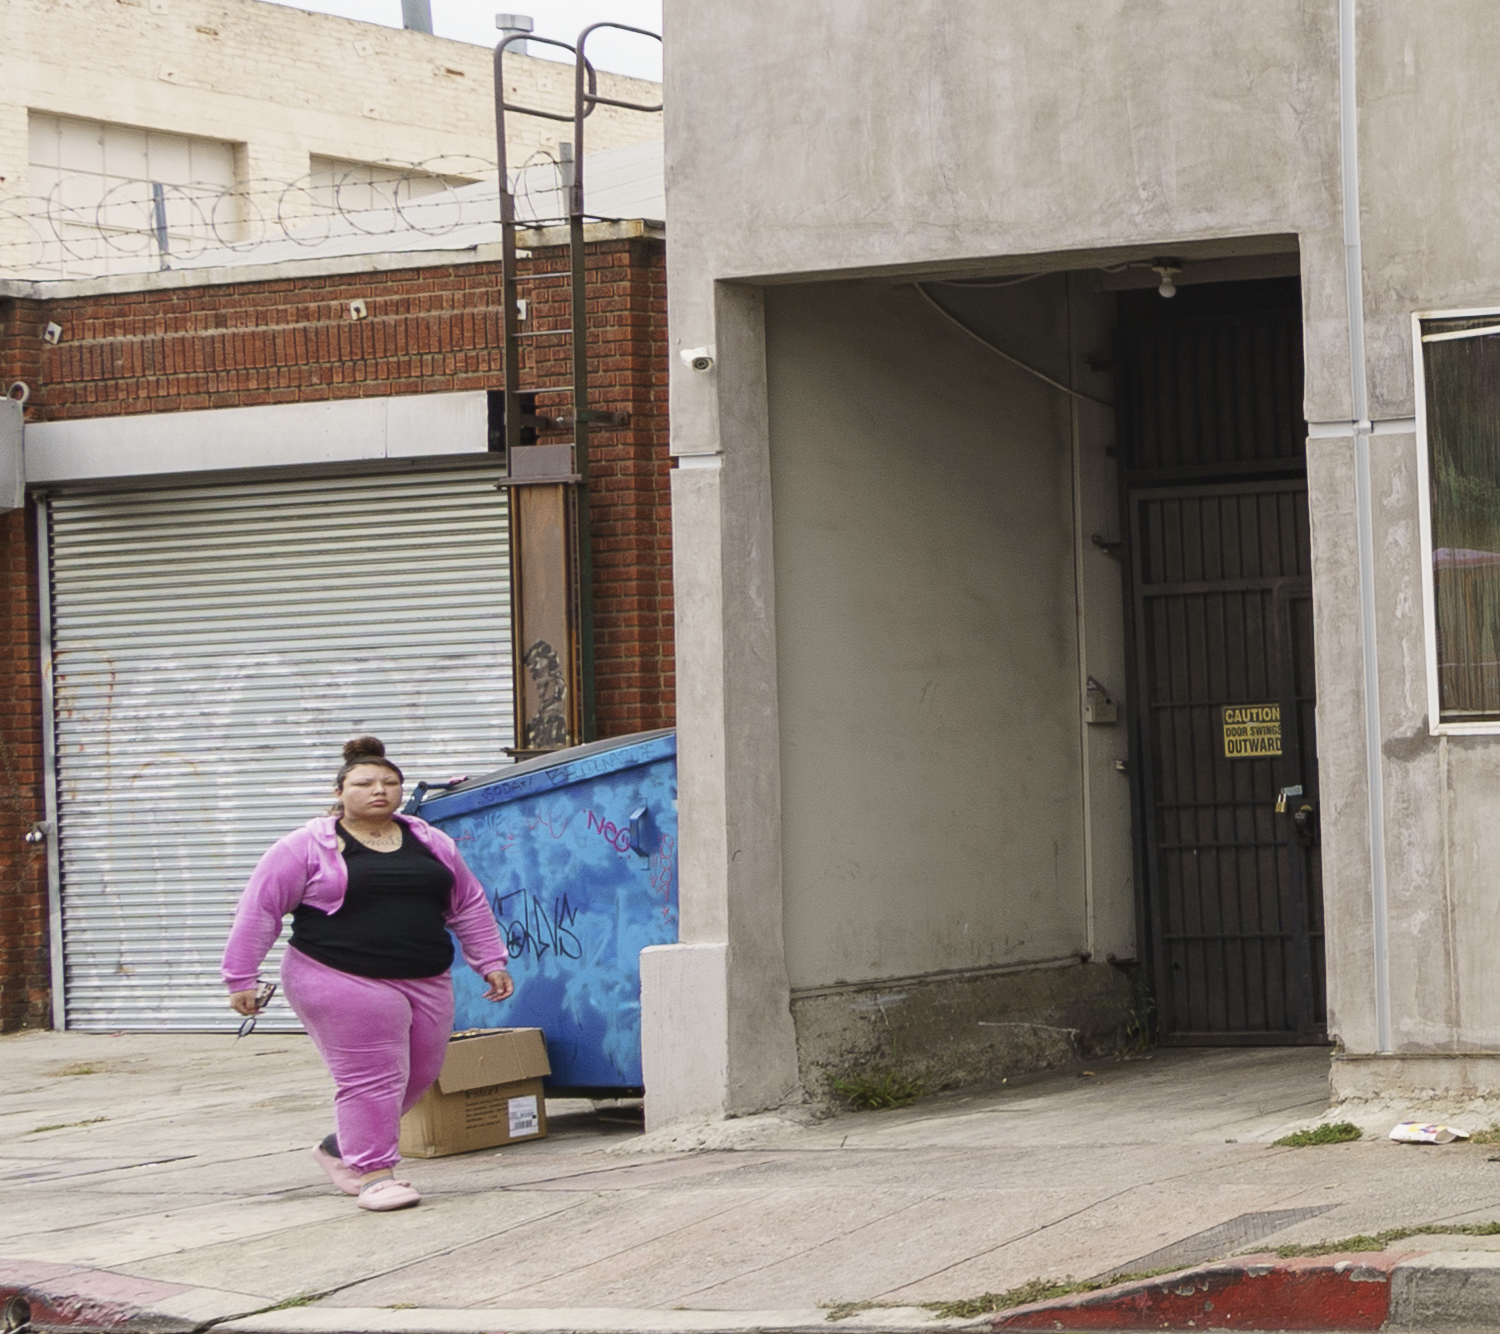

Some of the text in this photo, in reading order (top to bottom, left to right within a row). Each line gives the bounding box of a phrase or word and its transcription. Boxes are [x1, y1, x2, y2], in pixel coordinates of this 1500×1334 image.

[1225, 707, 1280, 723] CAUTION
[1226, 727, 1248, 737] DOOR
[1227, 737, 1281, 754] OUTWARD
